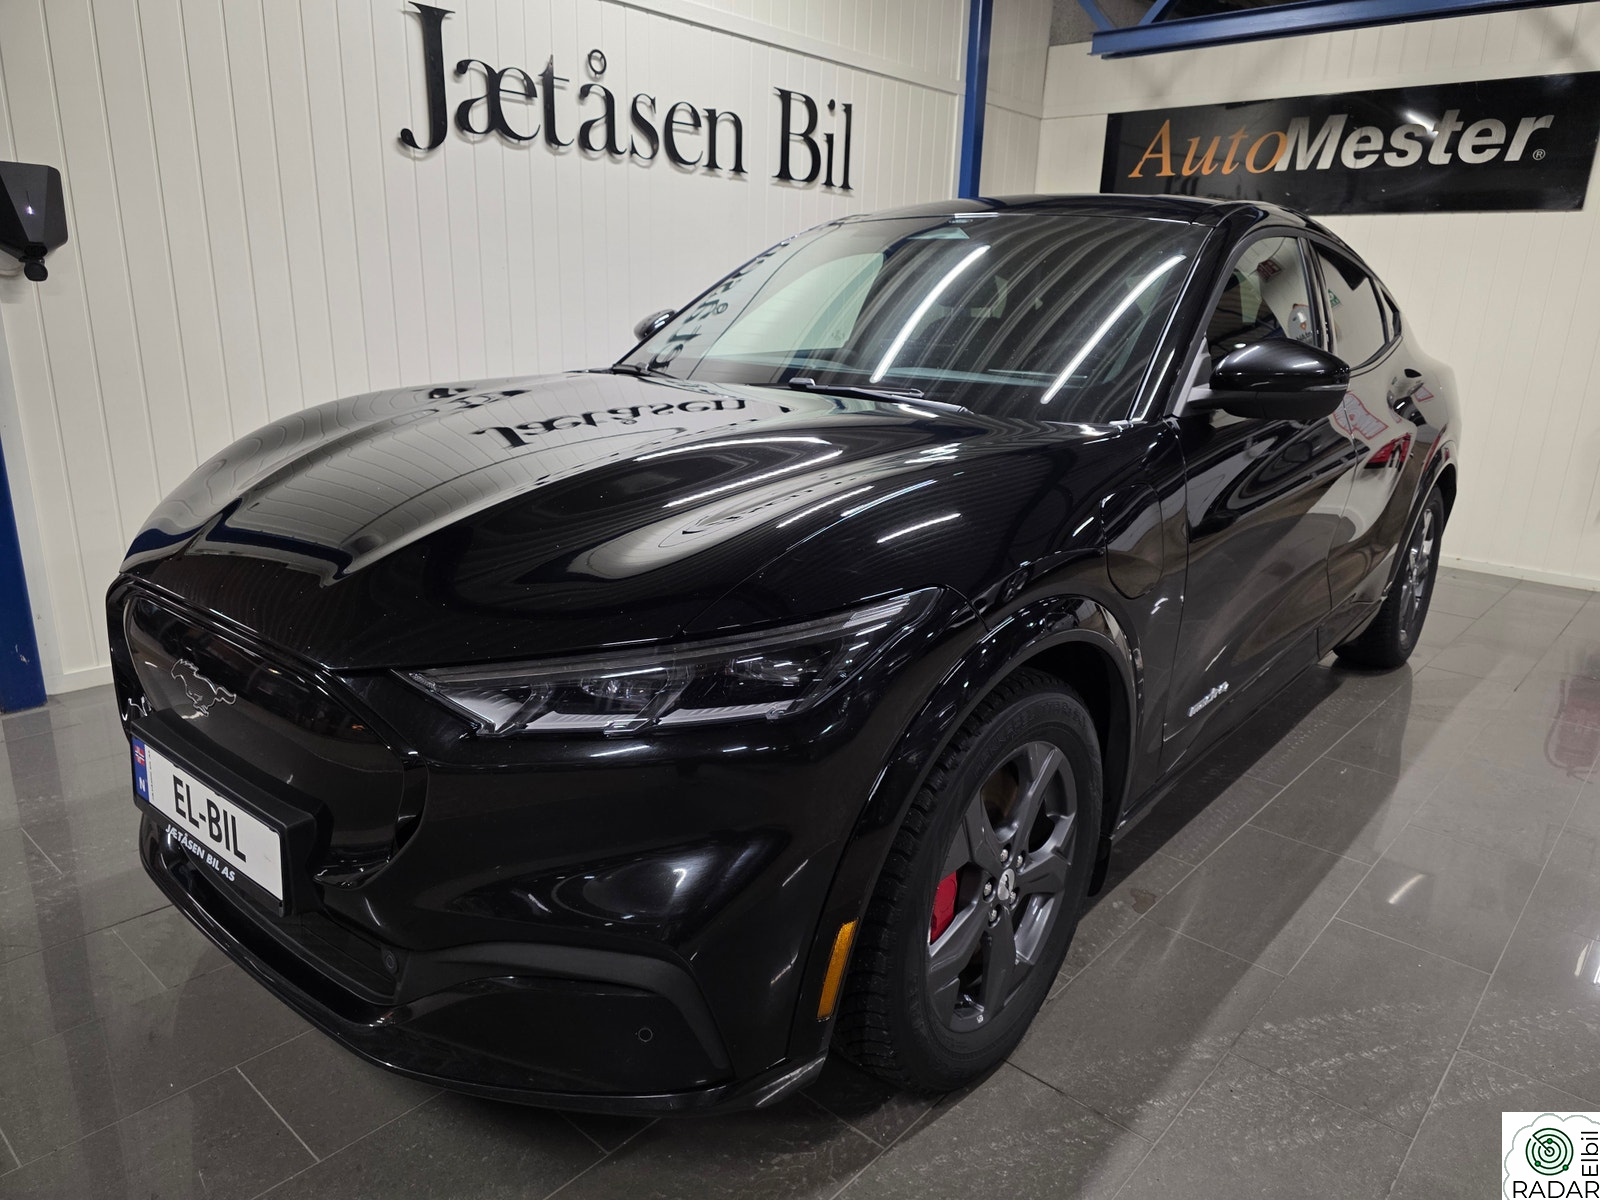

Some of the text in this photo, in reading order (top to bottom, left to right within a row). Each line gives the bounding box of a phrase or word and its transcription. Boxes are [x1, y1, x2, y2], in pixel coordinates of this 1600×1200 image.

[399, 1, 855, 191] Jætåsen Bil
[165, 823, 236, 882] JÆTÅSEN BIL AS
[172, 774, 247, 863] EL-BIL
